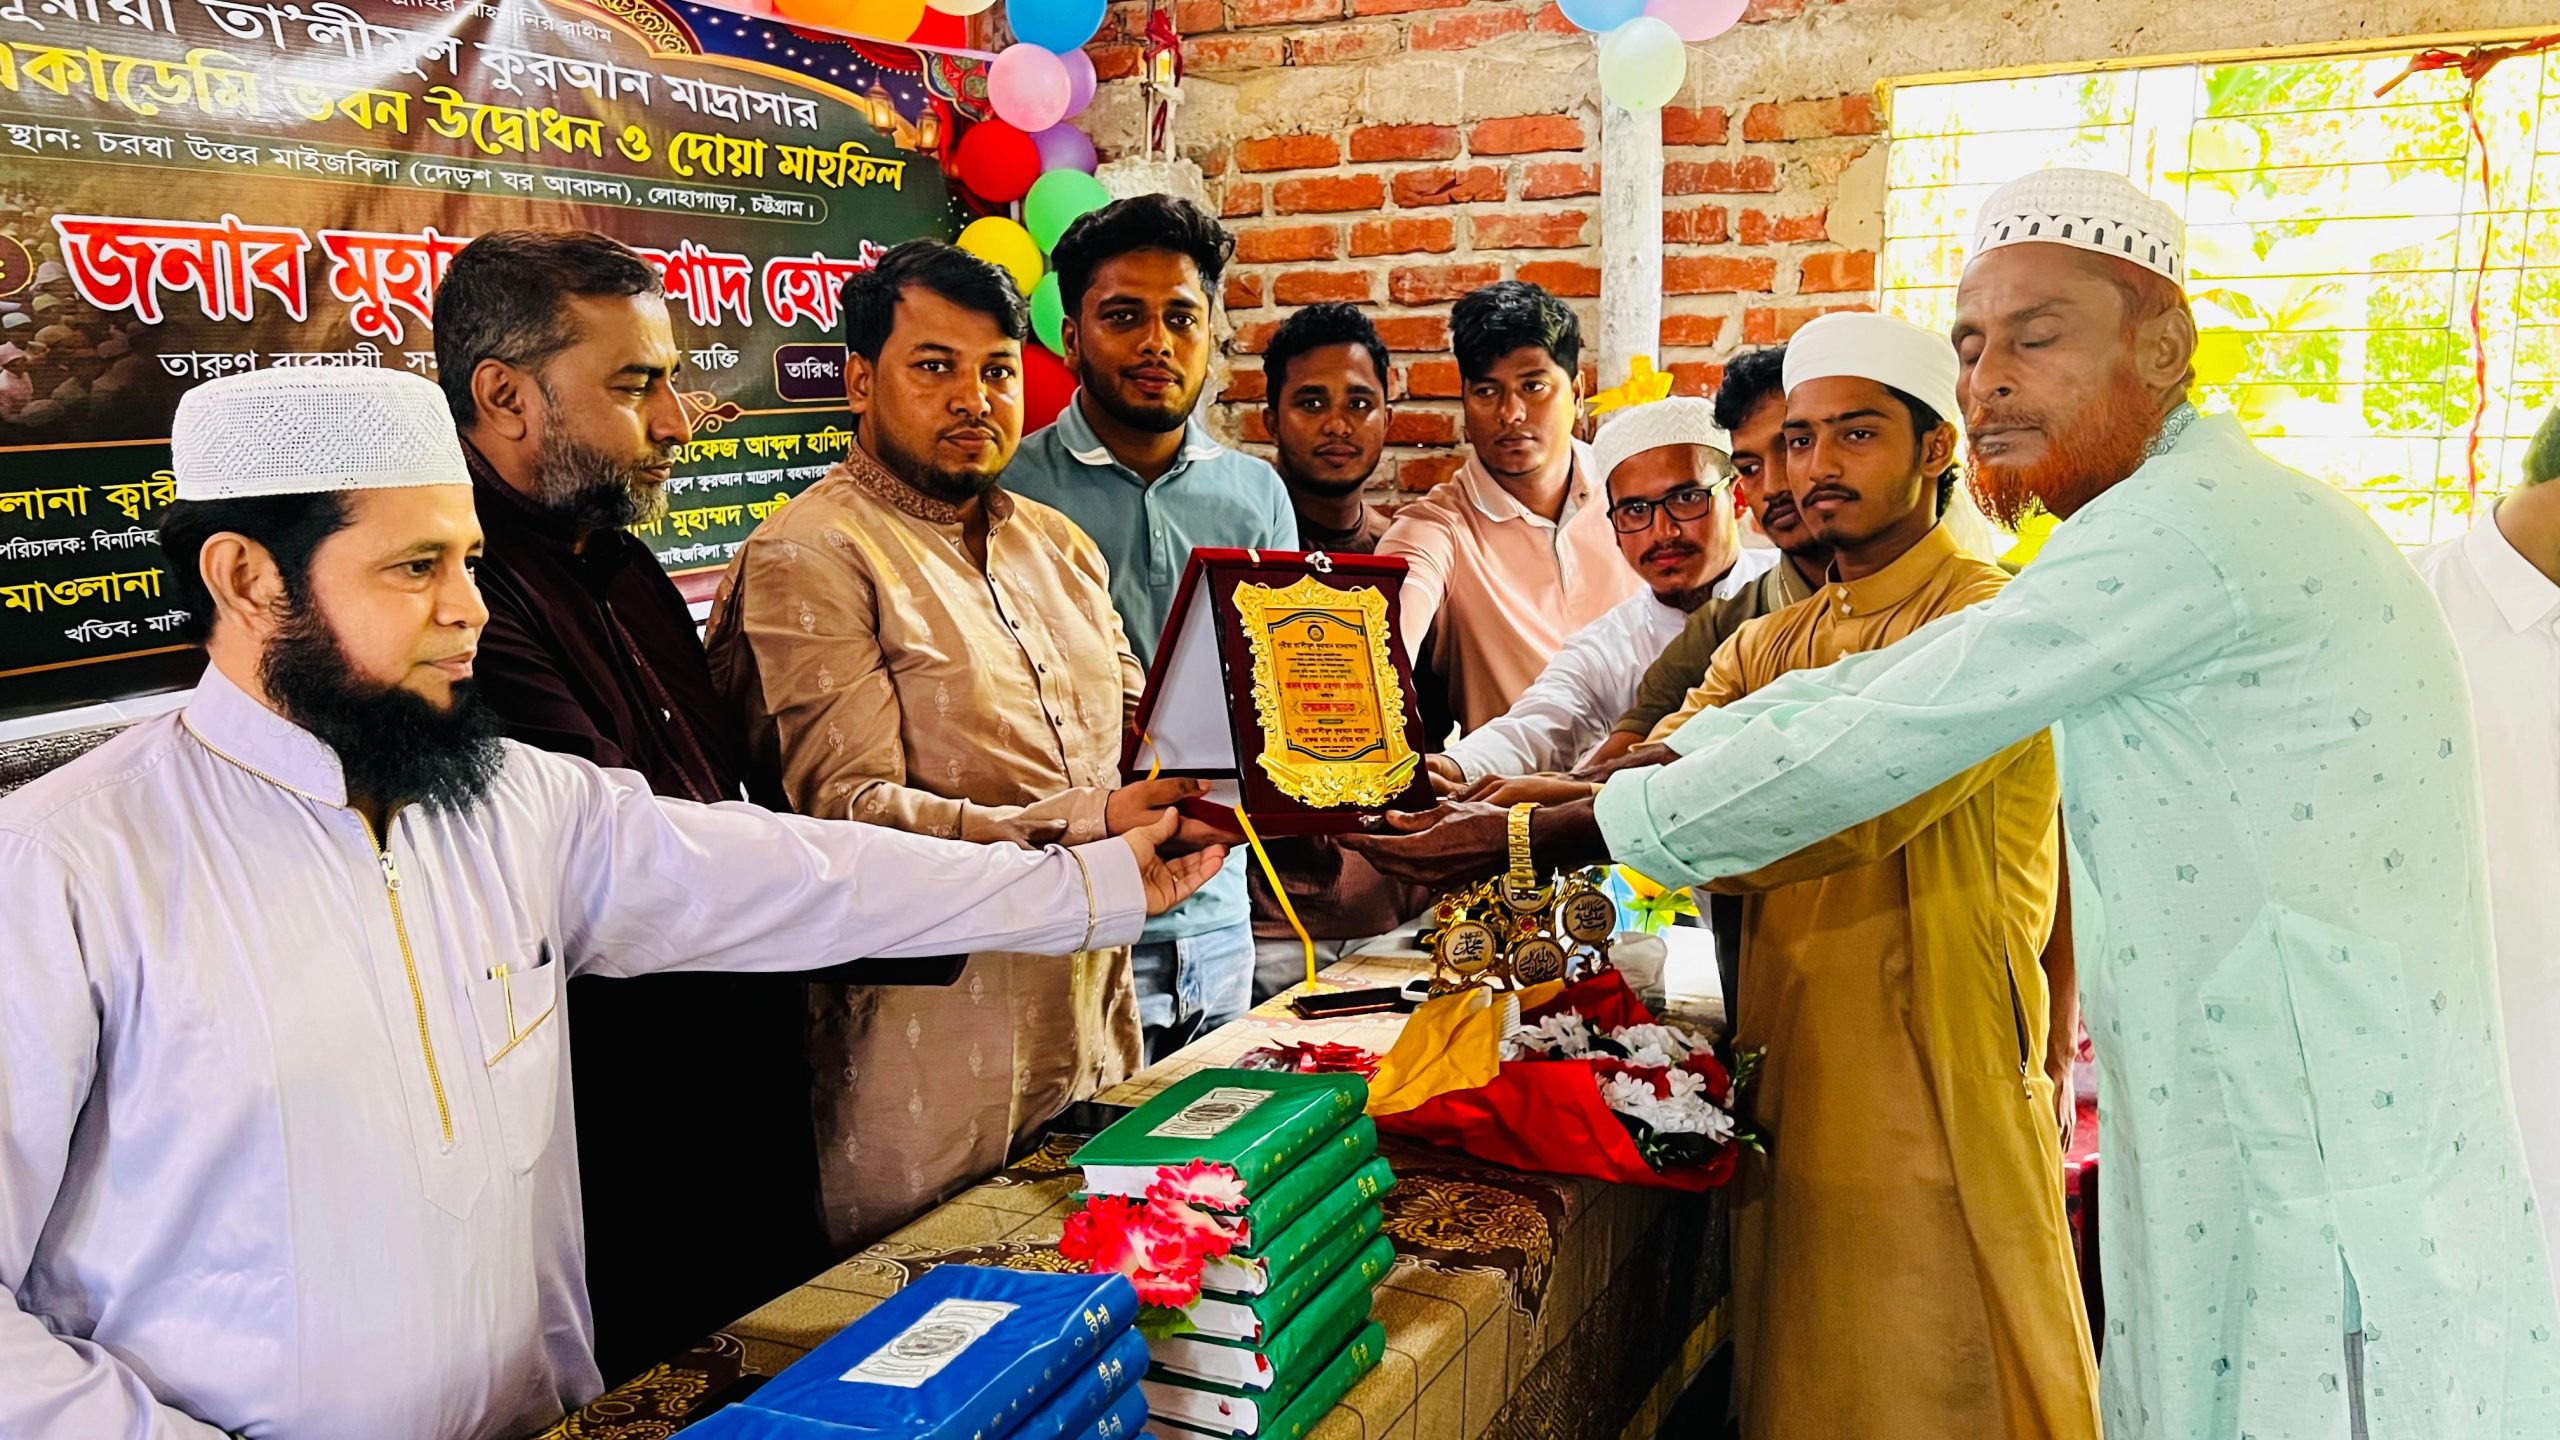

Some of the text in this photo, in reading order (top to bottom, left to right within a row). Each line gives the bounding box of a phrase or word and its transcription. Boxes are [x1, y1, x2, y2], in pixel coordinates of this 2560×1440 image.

[473, 41, 653, 106] কুরআন
[661, 74, 819, 131] মাদ্রাসার
[277, 75, 412, 135] ভবন
[423, 85, 605, 158] উদ্বোধন
[616, 125, 652, 163] ও
[668, 131, 769, 179] দোয়া
[774, 141, 907, 192] মাহফিল
[1, 123, 82, 154] স্থান:
[183, 132, 260, 166] উত্তর
[268, 144, 400, 180] মাইজবিলা
[408, 160, 493, 190] (দেড়শ
[498, 171, 535, 192] ঘর
[50, 212, 312, 326] জনাব
[317, 226, 476, 346] মুহা
[630, 238, 754, 327] শাদ
[689, 342, 740, 371] ব্যক্তি
[784, 356, 840, 379] তারিখ:
[743, 434, 802, 461] আব্দুল
[805, 425, 854, 454] হামিদ
[696, 472, 743, 492] কুরআন
[0, 484, 92, 520] লানা
[91, 525, 162, 551] বিনানিহ
[668, 504, 744, 538] মুহাম্মদ
[0, 567, 164, 614] মাওলানা
[64, 618, 138, 643] খতিব:
